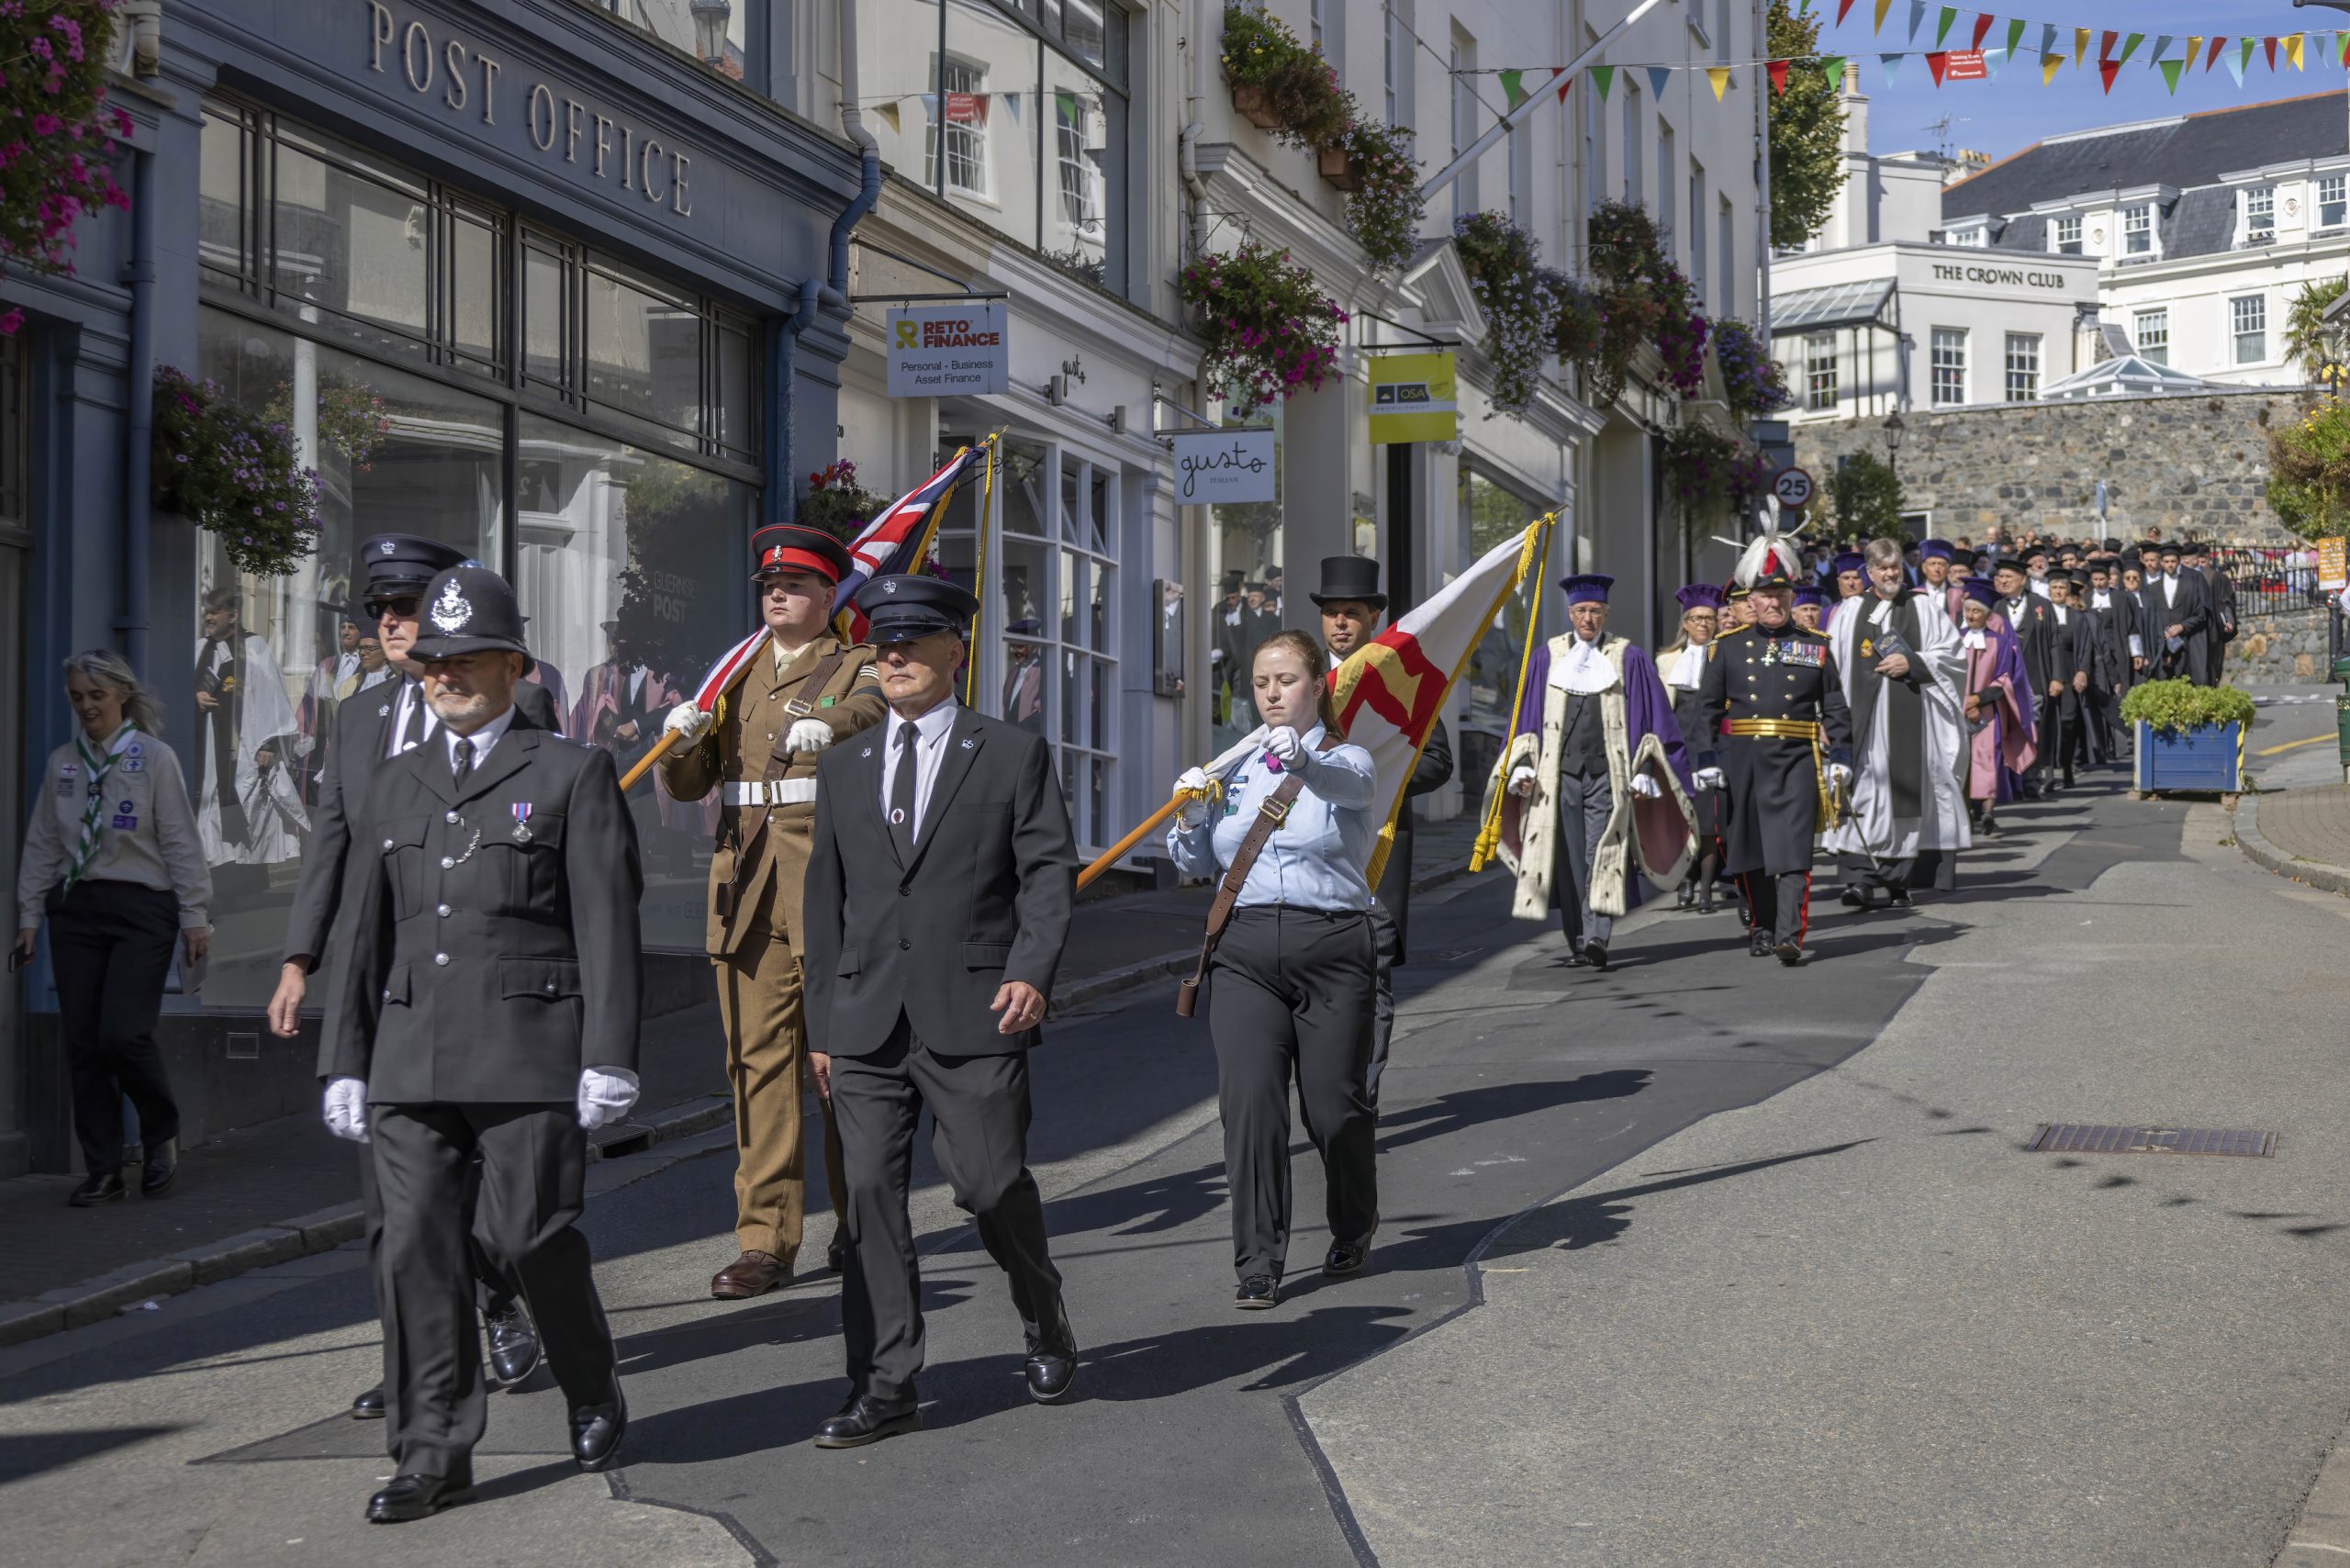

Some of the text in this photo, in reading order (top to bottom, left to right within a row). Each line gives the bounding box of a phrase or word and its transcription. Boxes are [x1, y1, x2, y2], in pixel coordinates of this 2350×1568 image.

[369, 1, 692, 218] POST OFFICE
[1932, 264, 2065, 288] THE CROWN CLUB
[923, 319, 970, 335] RETO
[923, 332, 1000, 348] FINANCE
[901, 361, 942, 372] Personal
[951, 359, 993, 370] Business
[914, 374, 981, 385] Asset Finance
[1062, 353, 1086, 398] gusto
[1400, 388, 1426, 400] OSA
[1181, 441, 1268, 498] gusto
[1779, 478, 1807, 497] 25
[654, 593, 688, 625] POST
